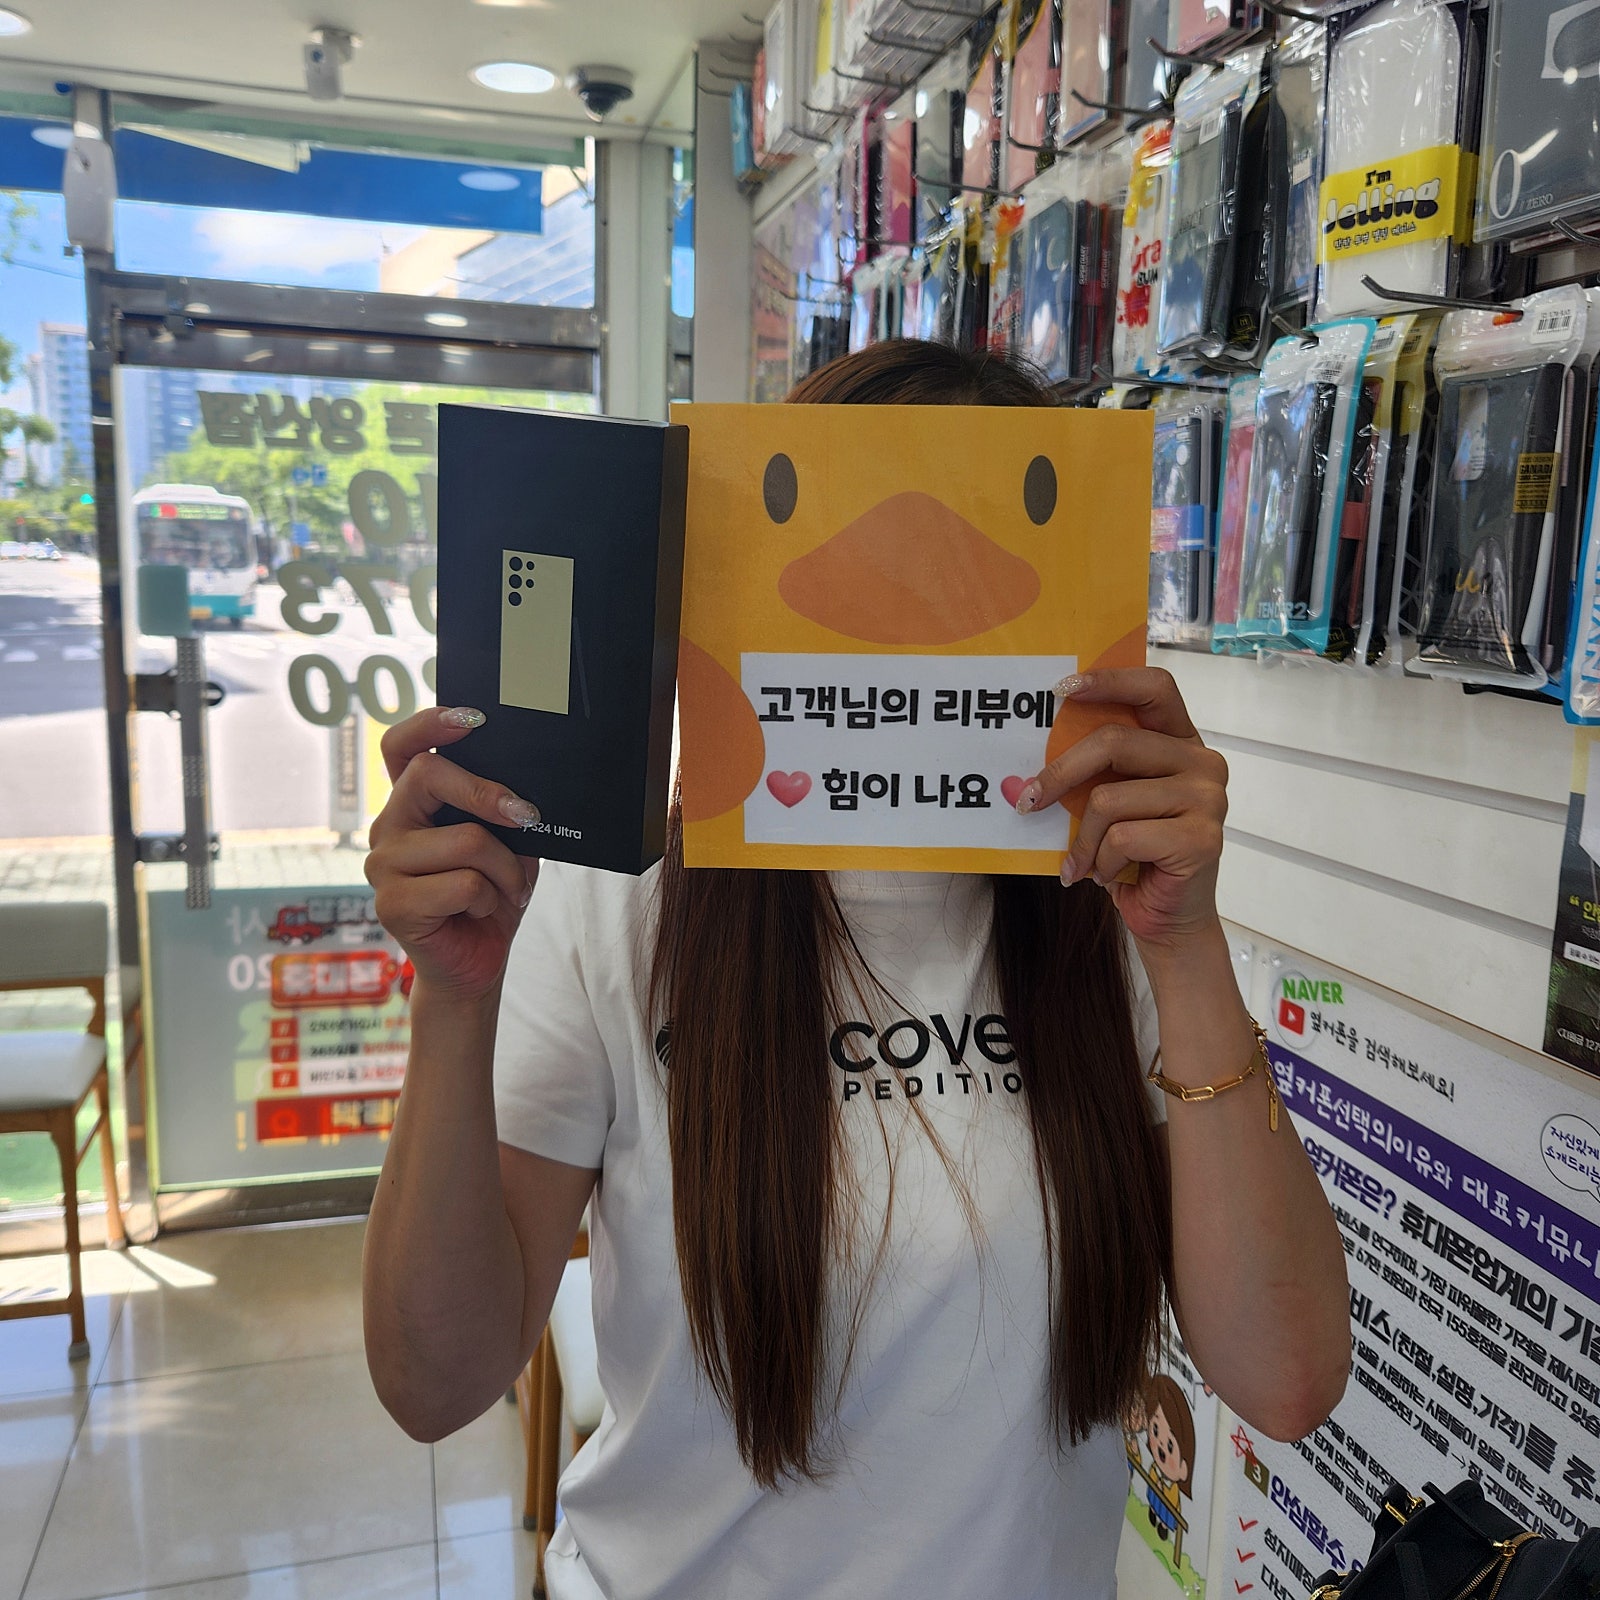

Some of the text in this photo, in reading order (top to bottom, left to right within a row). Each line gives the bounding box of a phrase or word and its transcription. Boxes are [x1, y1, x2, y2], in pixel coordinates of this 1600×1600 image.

[1365, 170, 1391, 187] I'm
[1323, 178, 1441, 234] Jelling
[758, 686, 1055, 729] 고객님의 리뷰에
[821, 768, 991, 811] 힘이 나요
[553, 825, 582, 840] Ultra
[1282, 978, 1344, 1004] NAVER
[1311, 1012, 1455, 1102] 옆커폰을 검색해보세요!
[1275, 1060, 1453, 1190] 옆커폰선택의이유와
[1400, 1199, 1558, 1331] 휴대폰업계의
[1371, 1230, 1419, 1280] 연구하며,
[1421, 1259, 1447, 1295] 가장
[1448, 1284, 1502, 1332] 파워풀한
[1502, 1322, 1547, 1369] 가격을
[1356, 1250, 1382, 1275] 67만
[1382, 1263, 1418, 1303] 회원과
[1418, 1292, 1444, 1322] 전국
[1446, 1309, 1508, 1368] 155호점을
[1508, 1356, 1568, 1413] 관리하고
[1322, 1416, 1346, 1444] 격을
[1345, 1434, 1367, 1467] 위해
[1356, 1339, 1379, 1370] 일을
[1379, 1360, 1426, 1409] 사랑하는
[1426, 1398, 1477, 1451] 사람들이
[1477, 1438, 1506, 1474] 일을
[1506, 1462, 1536, 1498] 하는
[1334, 1453, 1366, 1491] 만드는
[1413, 1414, 1450, 1457] 기분을
[1466, 1460, 1483, 1482] 잘
[1315, 1457, 1345, 1497] 영업할
[1563, 1454, 1600, 1505] 추
[1252, 1466, 1262, 1484] 3
[1270, 1474, 1347, 1571] 안심할수
